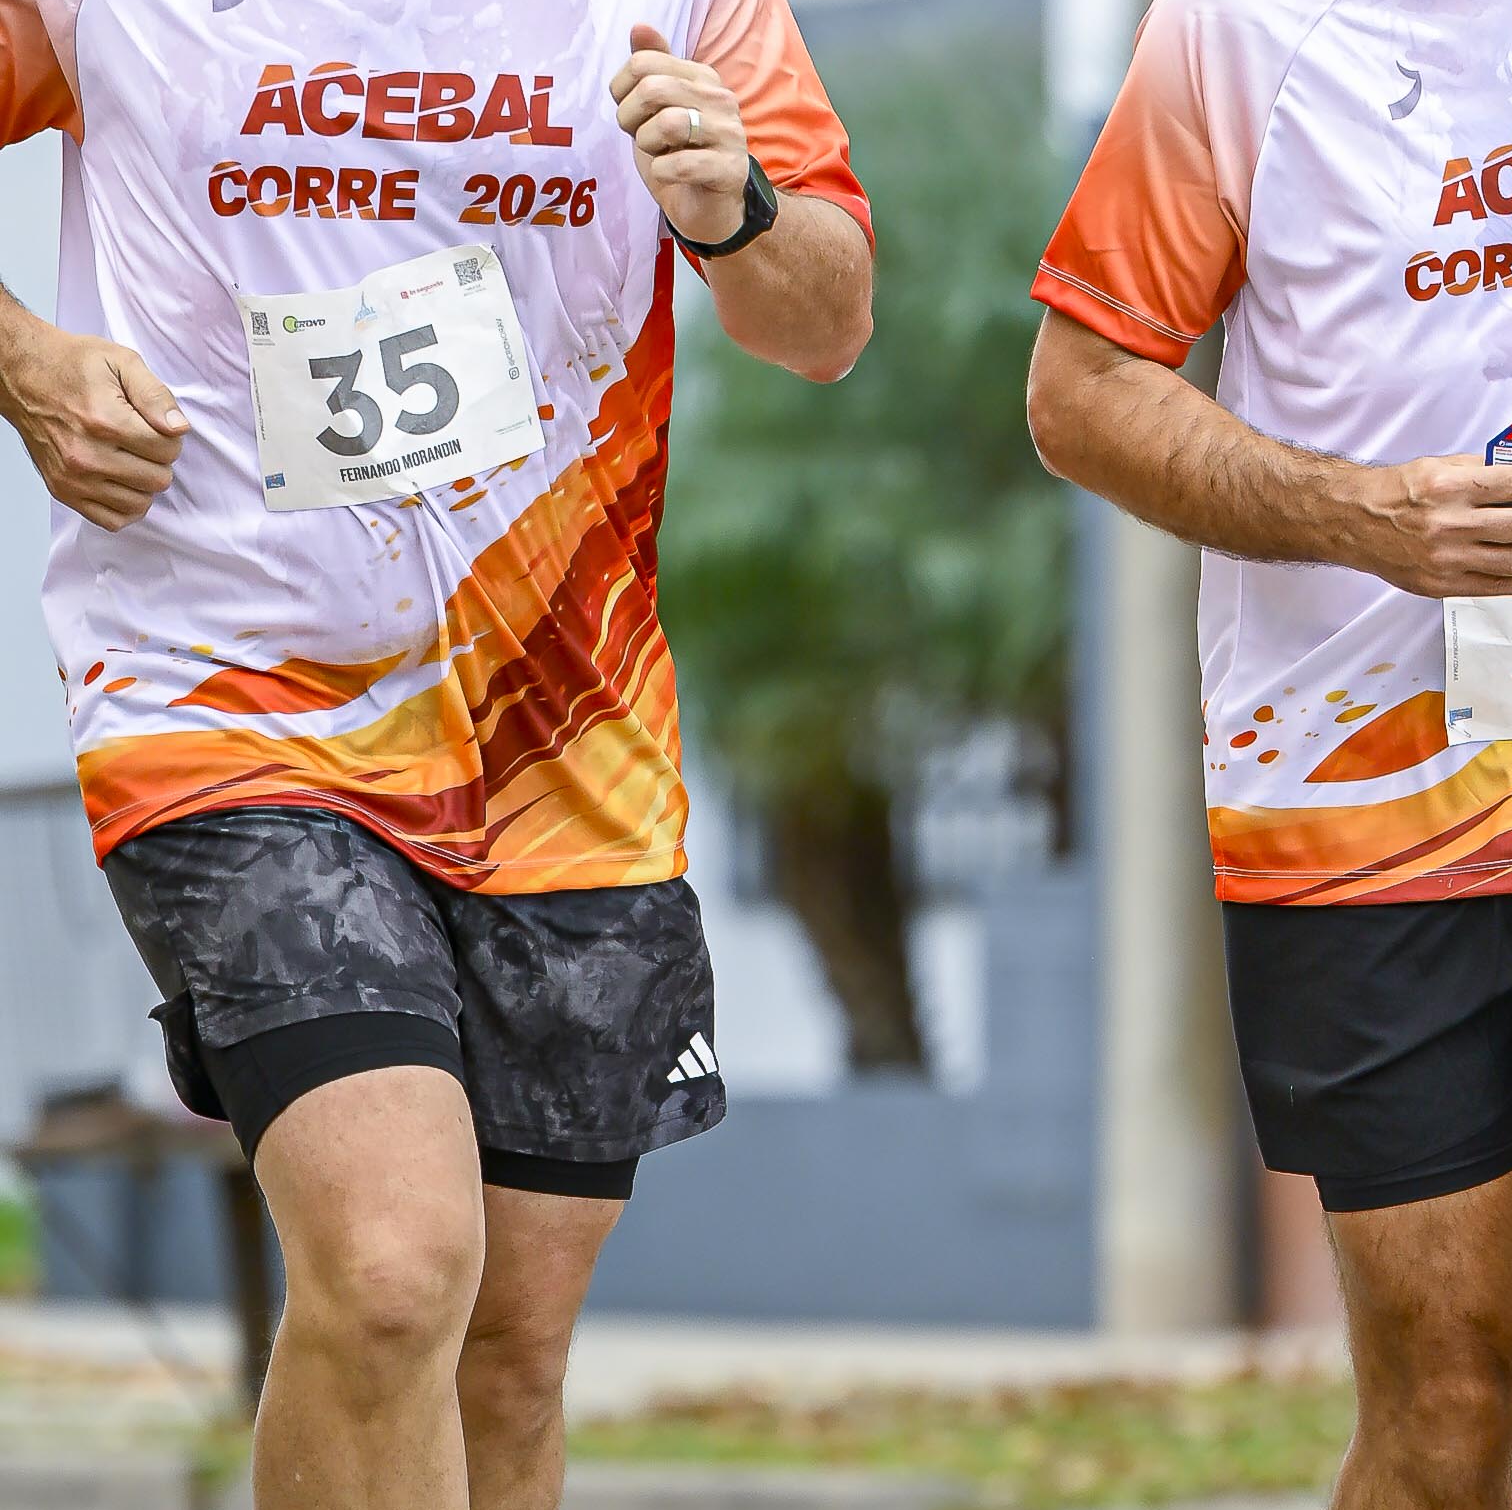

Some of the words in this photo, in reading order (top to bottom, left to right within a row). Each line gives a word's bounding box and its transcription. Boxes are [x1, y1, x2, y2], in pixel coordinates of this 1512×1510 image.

[239, 62, 573, 147] ACEBAL
[208, 160, 420, 220] CORRE
[458, 174, 597, 227] 2026
[308, 324, 459, 456] 35
[340, 458, 401, 482] FERNANDO
[401, 439, 462, 470] MORANDIN
